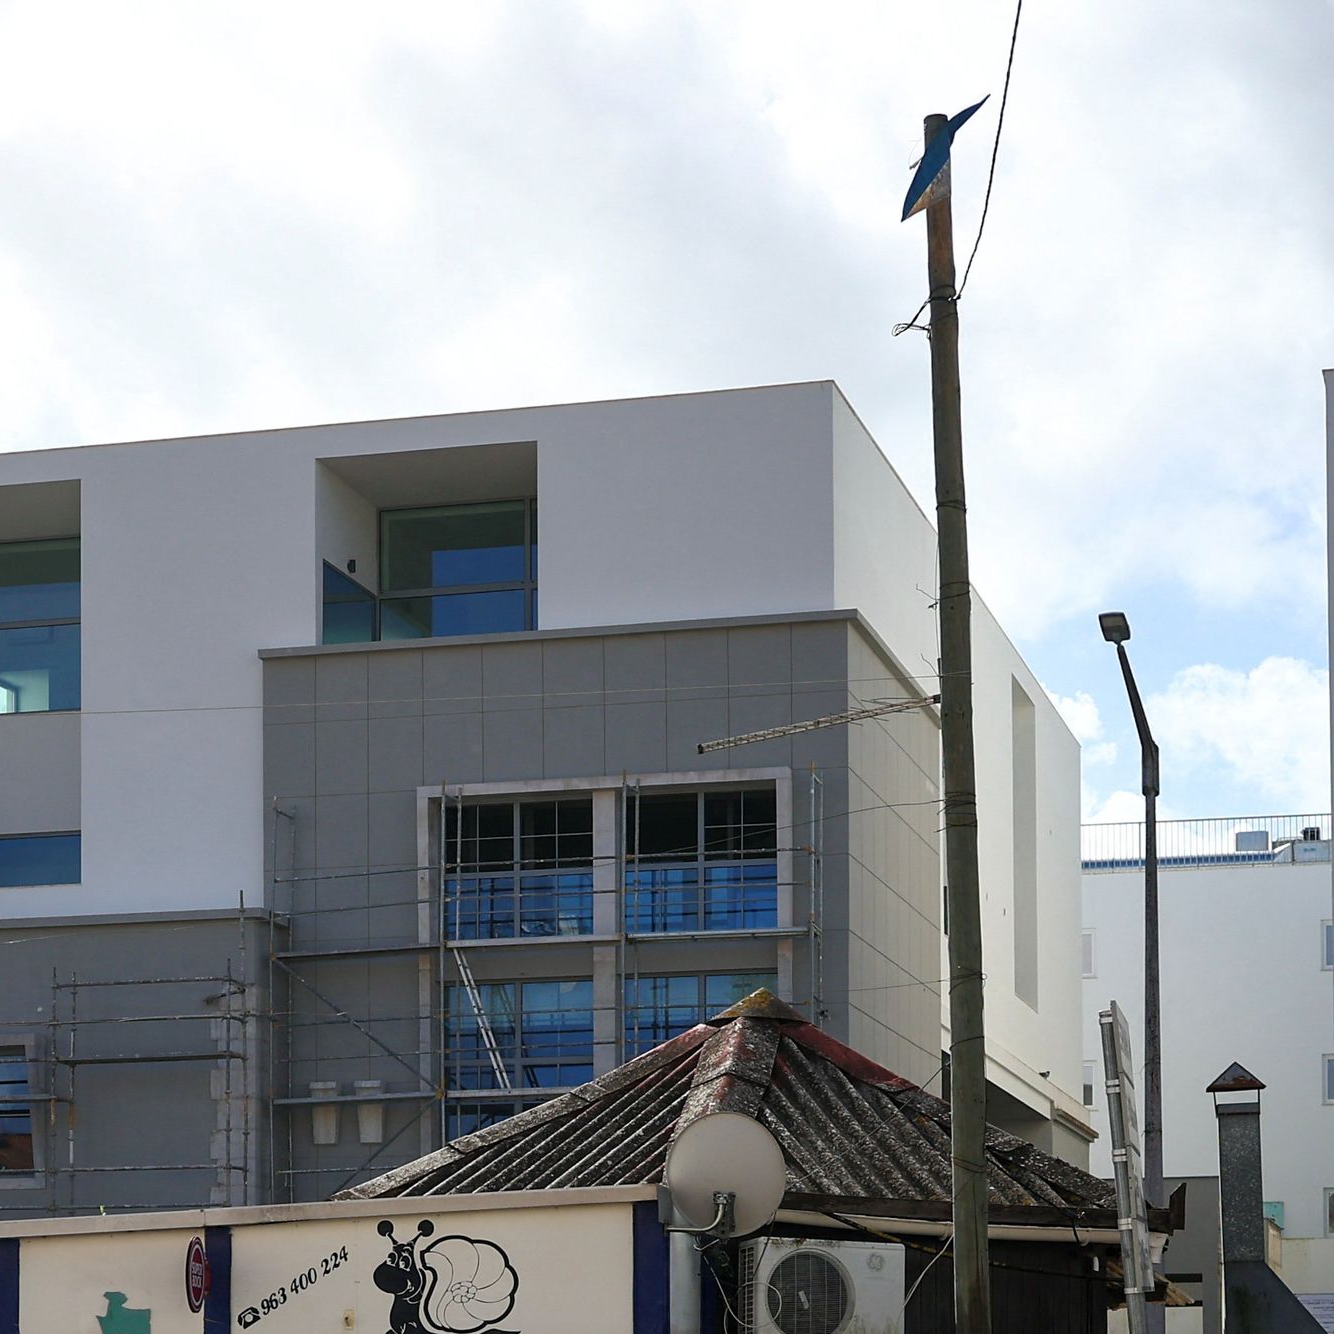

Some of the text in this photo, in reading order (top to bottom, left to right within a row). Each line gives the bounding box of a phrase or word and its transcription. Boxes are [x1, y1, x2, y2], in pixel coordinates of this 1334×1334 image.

[260, 1245, 349, 1316] 963 400 224
